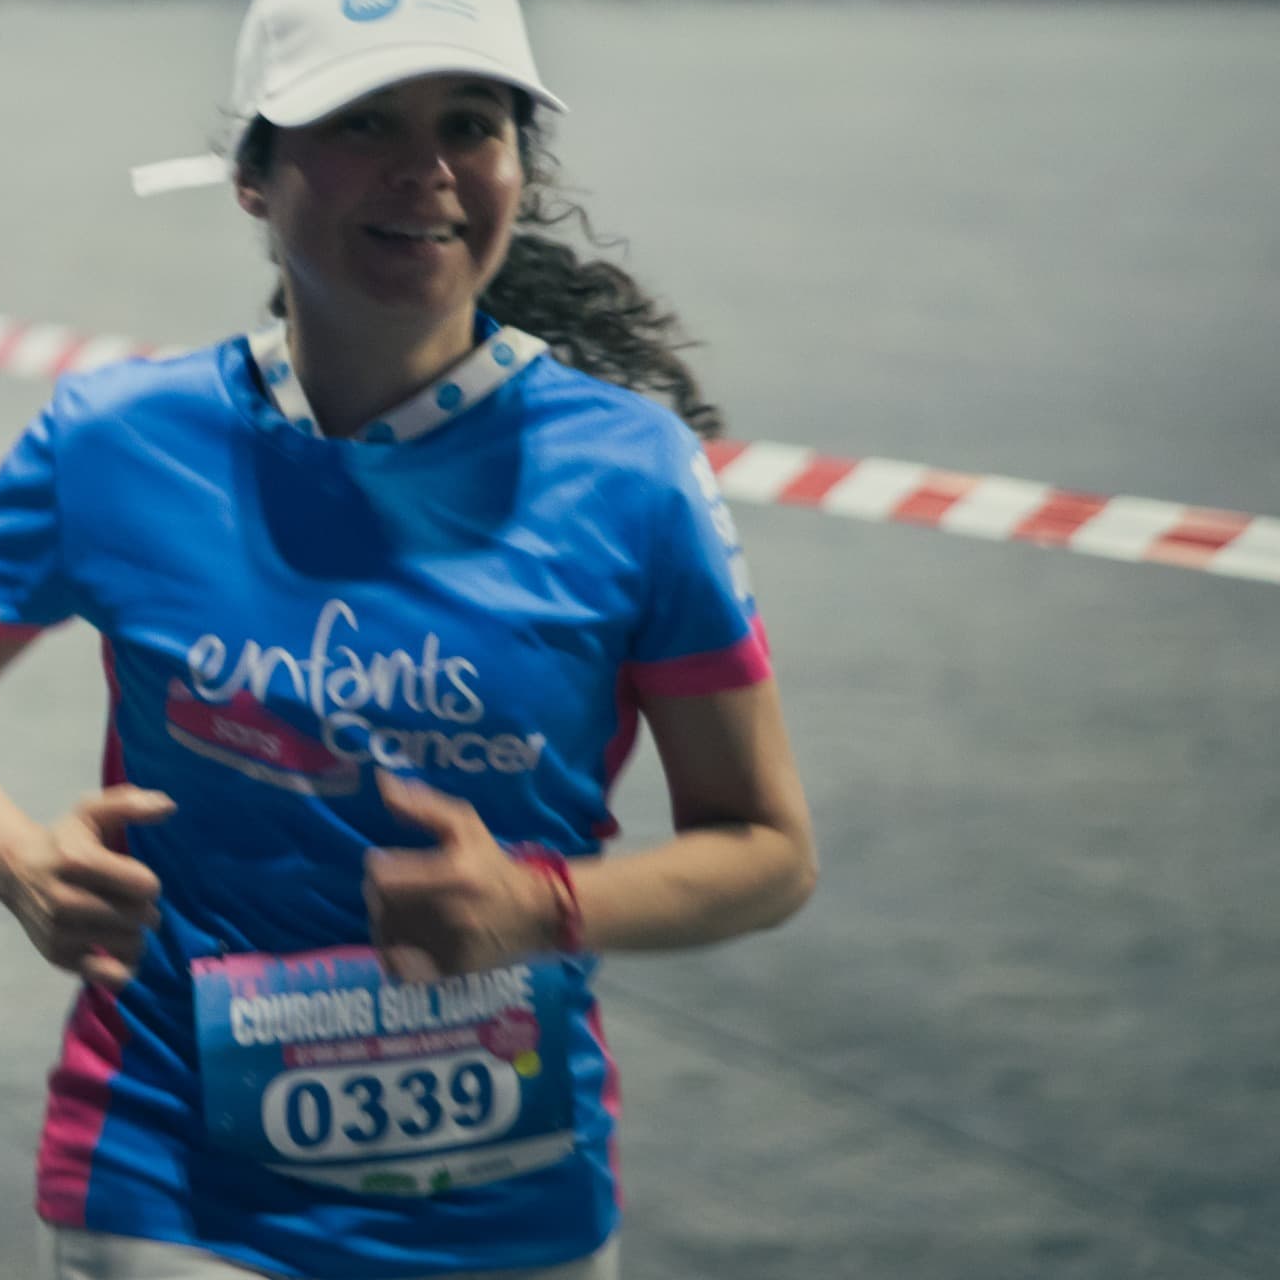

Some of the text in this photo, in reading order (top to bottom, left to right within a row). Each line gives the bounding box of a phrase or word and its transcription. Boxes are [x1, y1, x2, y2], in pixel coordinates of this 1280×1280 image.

[186, 598, 485, 723] enfants
[323, 711, 547, 774] Cancer
[229, 986, 376, 1047] COURONS
[284, 1060, 496, 1147] 0339
